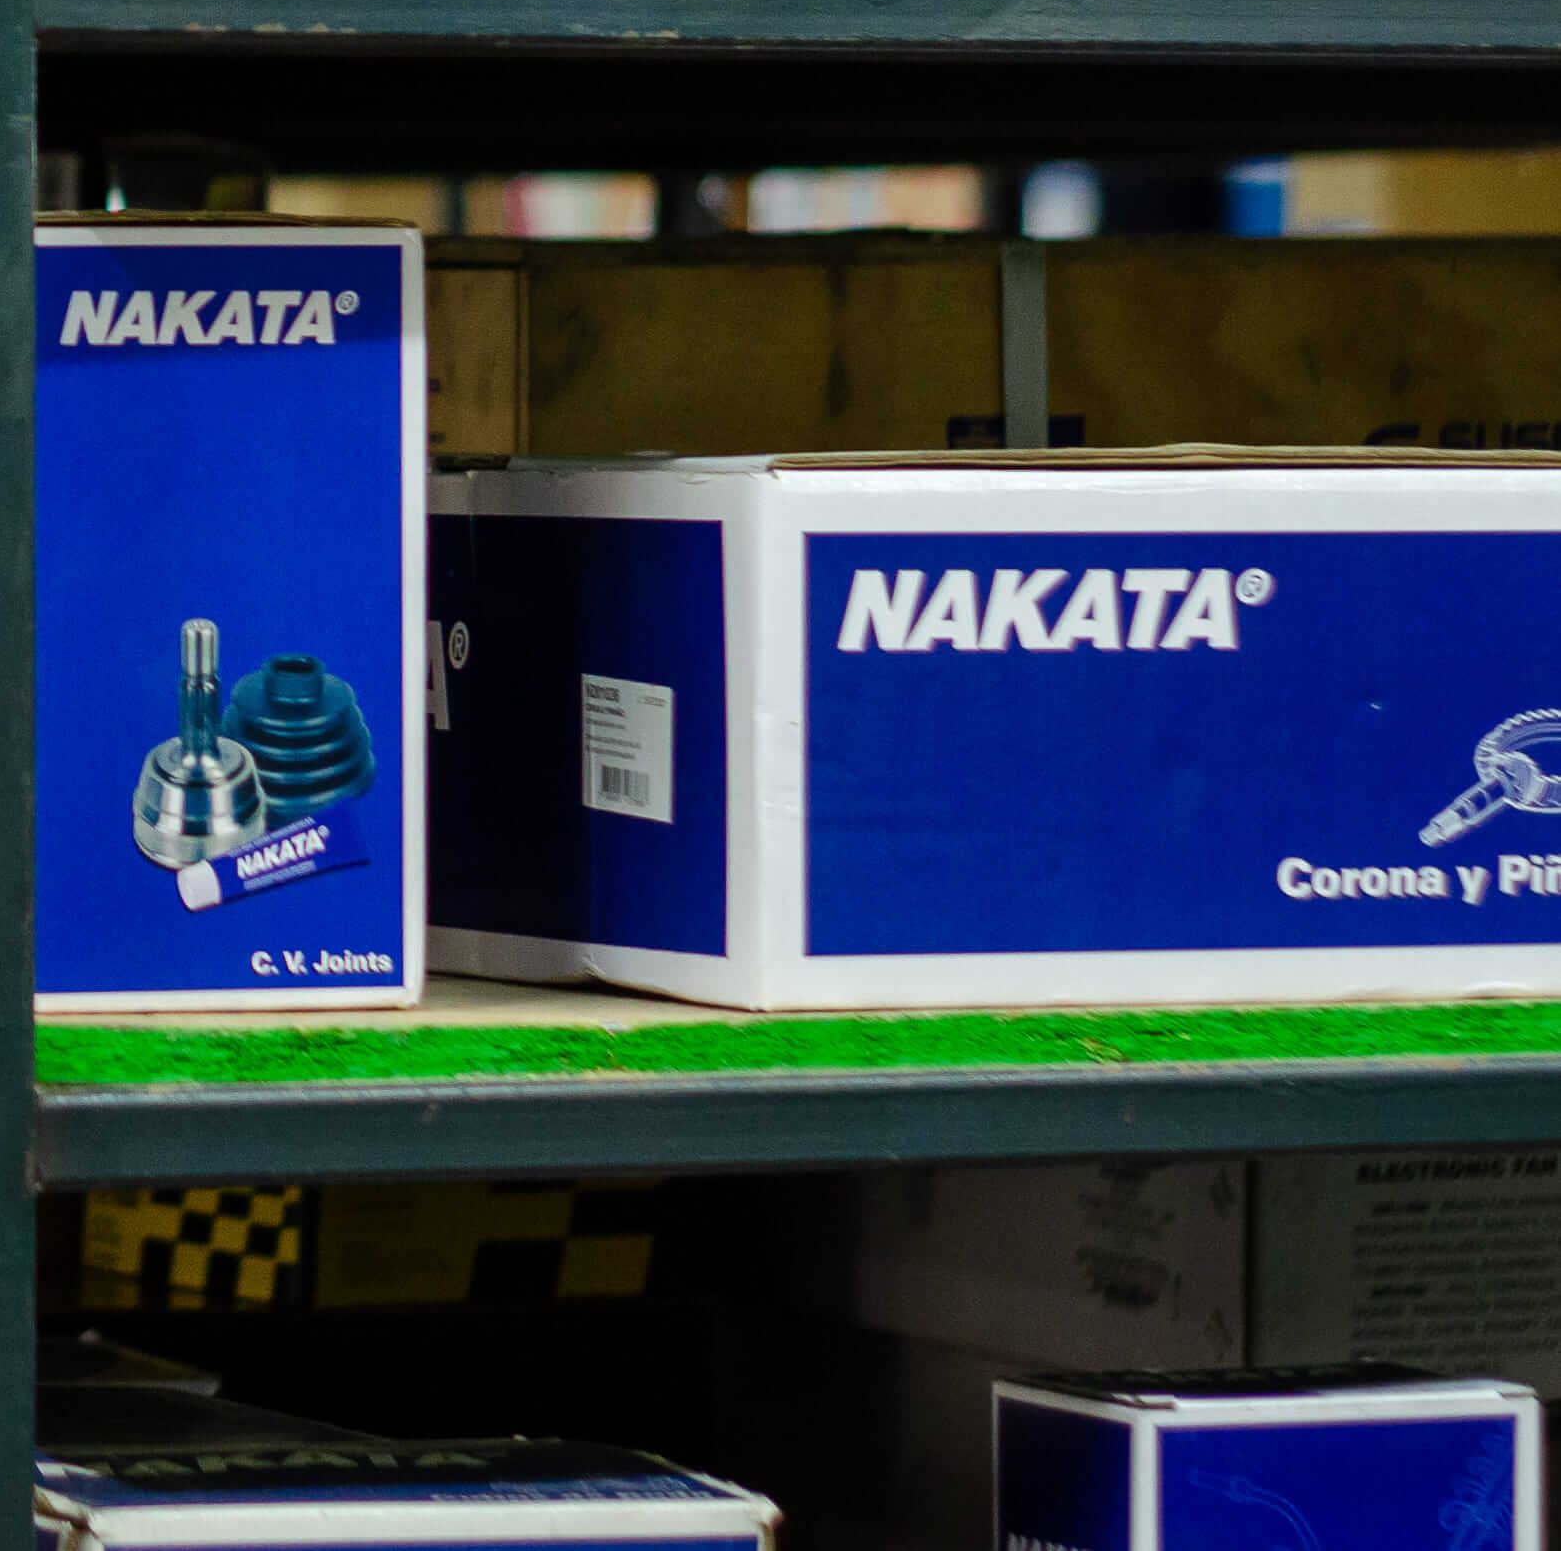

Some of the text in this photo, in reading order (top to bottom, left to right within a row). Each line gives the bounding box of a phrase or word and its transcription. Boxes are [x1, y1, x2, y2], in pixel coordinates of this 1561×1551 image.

[1277, 857, 1450, 898] Corona
[1456, 865, 1490, 906] y
[251, 950, 394, 975] C. V. Joints
